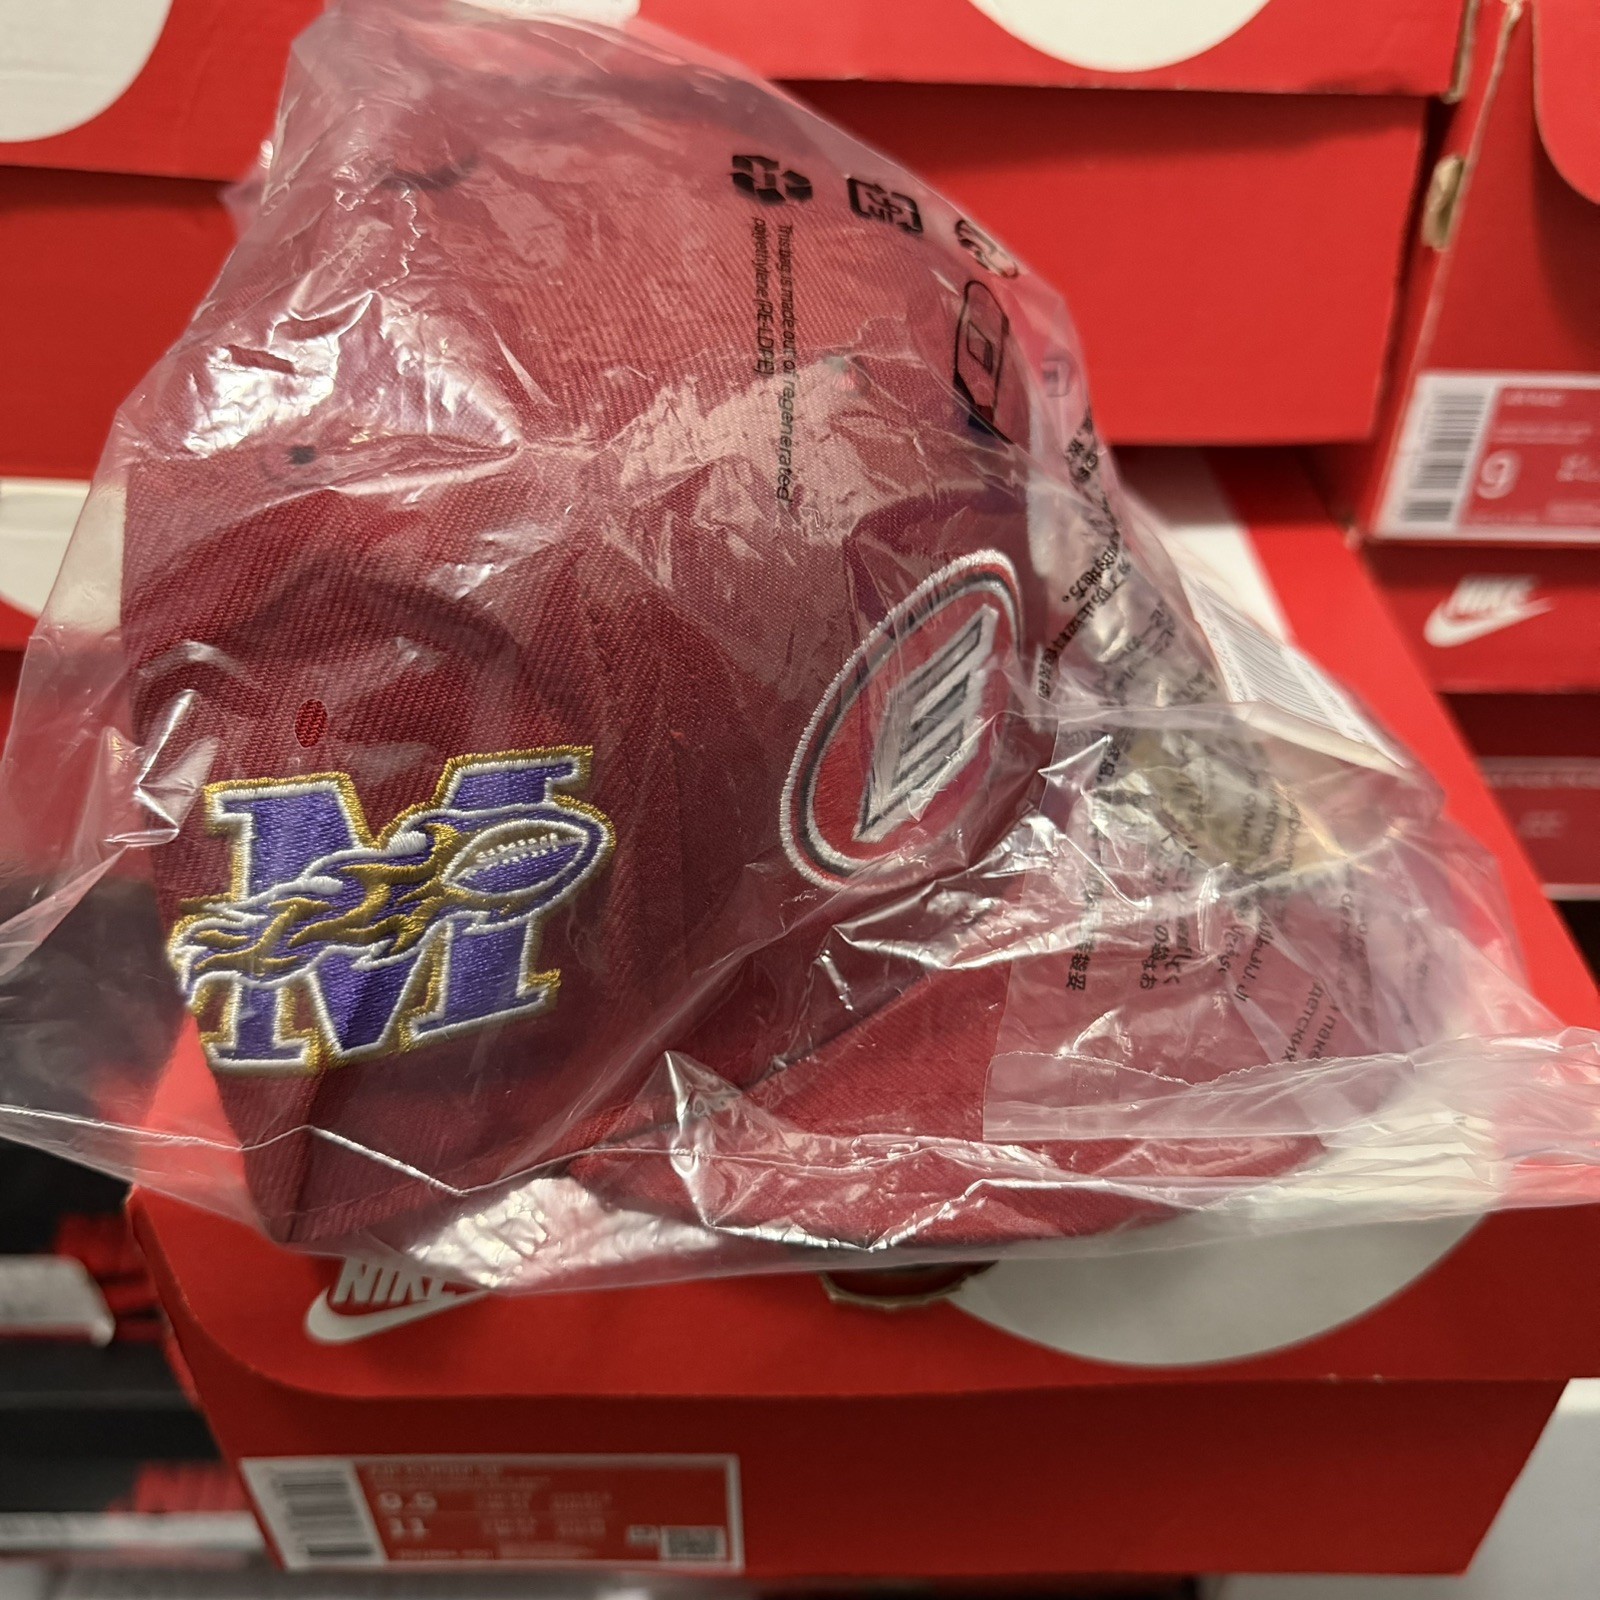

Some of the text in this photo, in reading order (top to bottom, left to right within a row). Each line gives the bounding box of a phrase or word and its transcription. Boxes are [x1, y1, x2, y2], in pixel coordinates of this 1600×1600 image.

[781, 288, 798, 327] made
[776, 380, 795, 504] regenerated
[1477, 452, 1519, 500] 9
